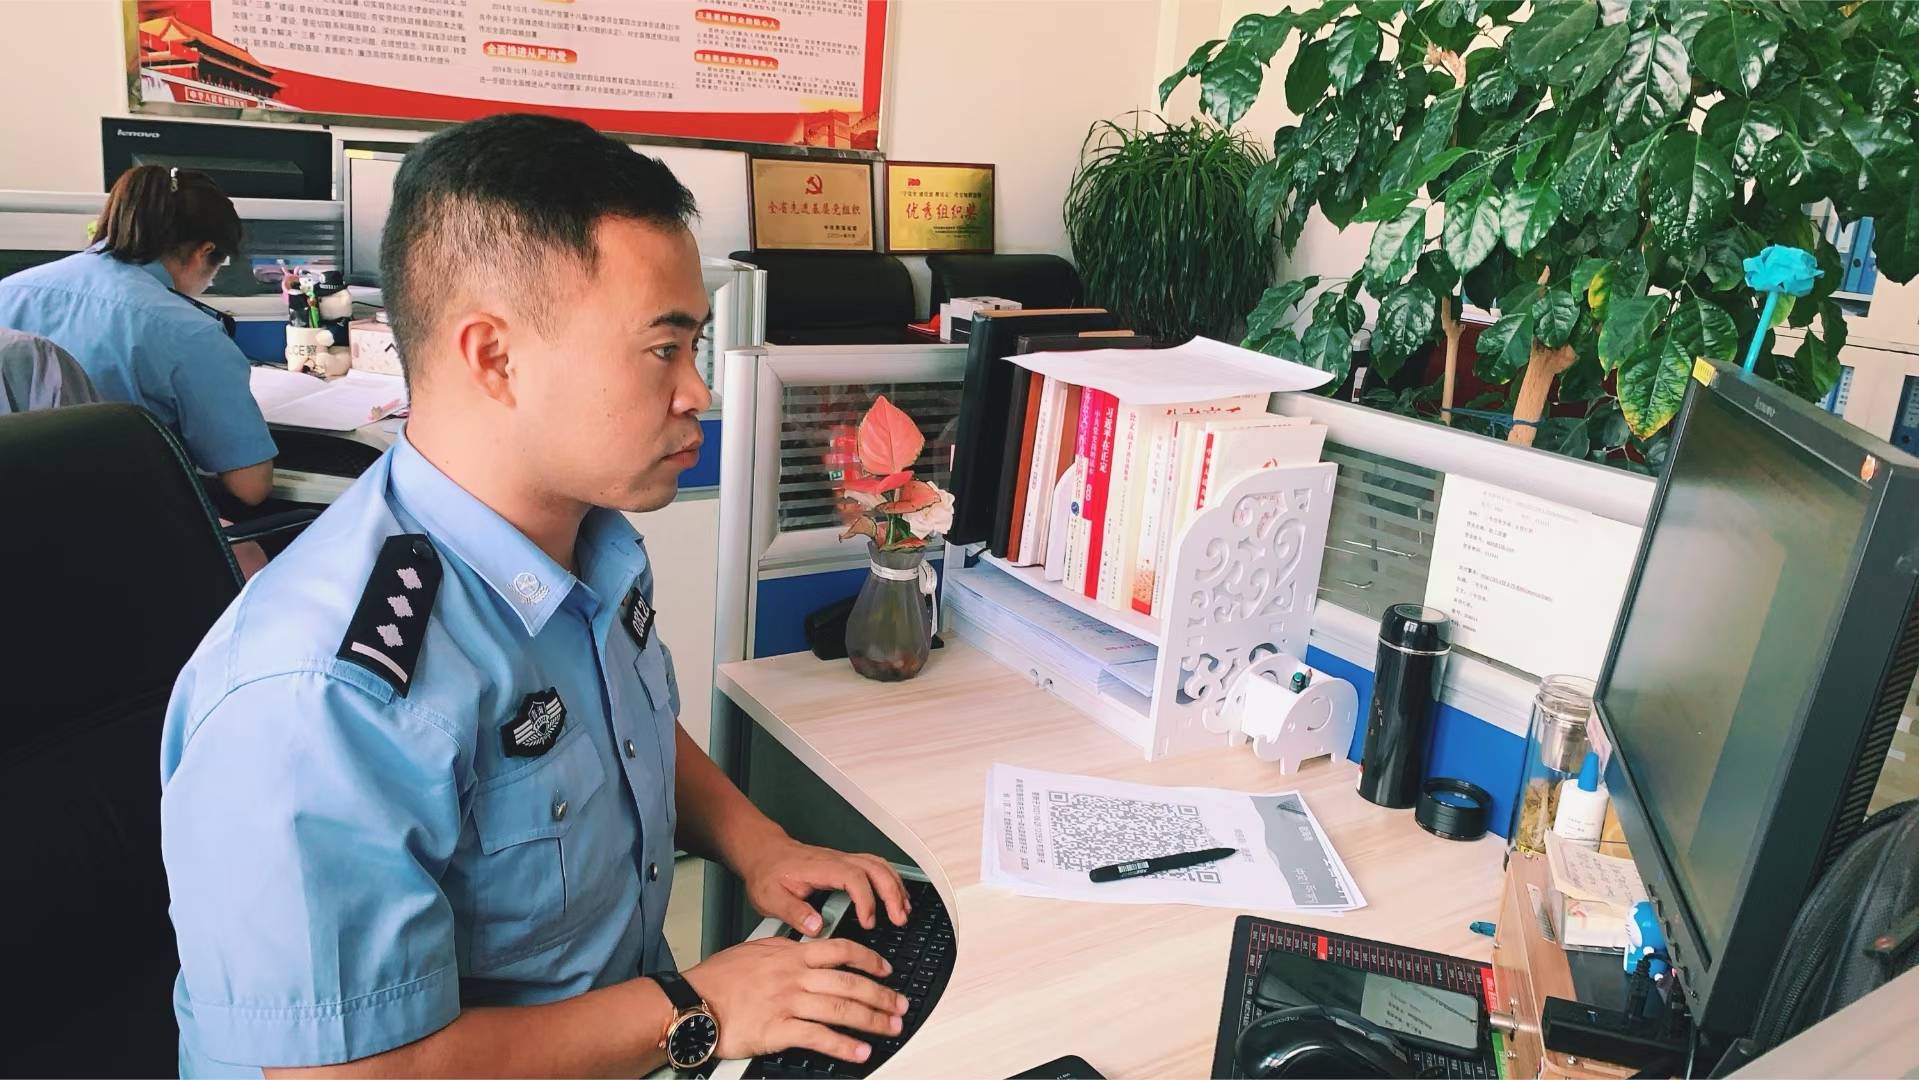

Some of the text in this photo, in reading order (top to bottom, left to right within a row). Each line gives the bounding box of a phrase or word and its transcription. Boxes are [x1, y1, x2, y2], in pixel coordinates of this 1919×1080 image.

[487, 43, 568, 62] 全面推进从严治党
[117, 129, 160, 138] lenovo
[768, 200, 860, 216] 全省先进基层党组织
[1099, 407, 1114, 473] 习近平在正定
